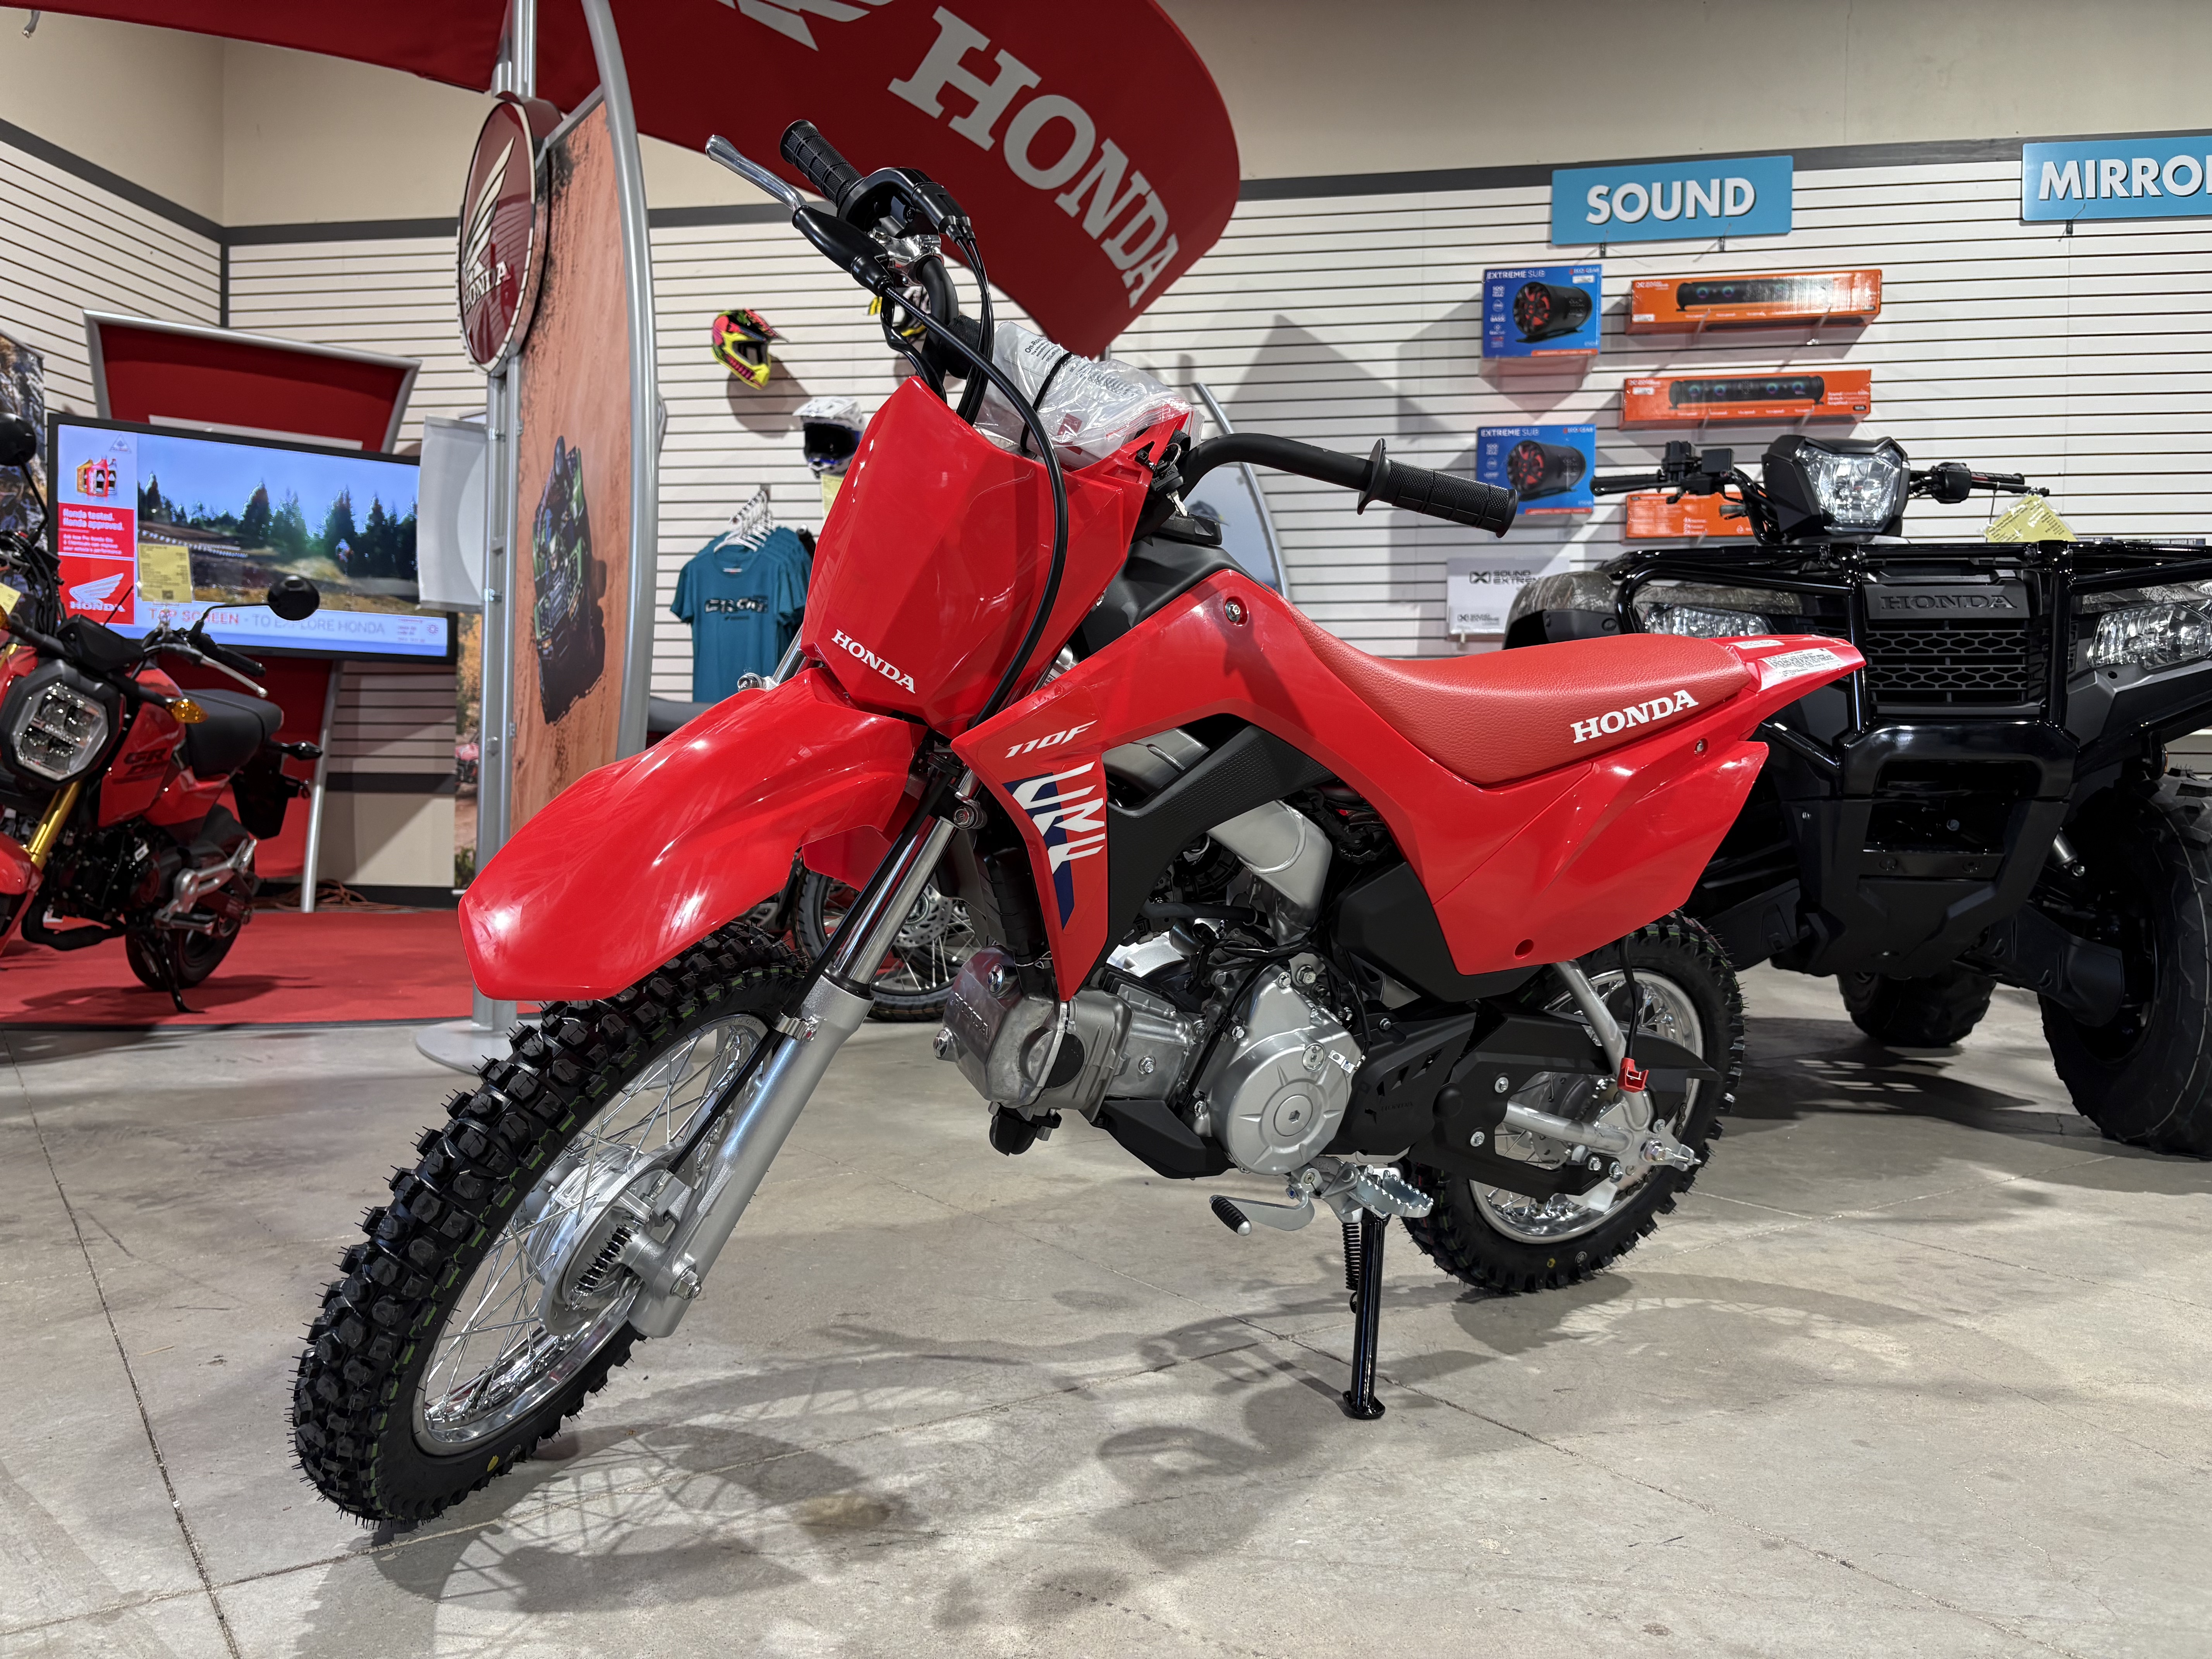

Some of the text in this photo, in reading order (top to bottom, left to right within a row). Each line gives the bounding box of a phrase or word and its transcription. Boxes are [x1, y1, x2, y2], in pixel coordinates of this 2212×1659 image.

[887, 5, 1179, 309] HONDA
[2038, 155, 2212, 201] MIRRO
[1586, 177, 1756, 225] SOUND
[1486, 271, 1527, 280] EXTREME
[1522, 428, 1539, 436] SUB
[70, 601, 126, 612] HONDA
[1880, 595, 2018, 610] HONDA
[252, 614, 270, 627] TO
[338, 619, 385, 635] HONDA
[831, 629, 916, 694] HONDA
[1570, 689, 1699, 744] HONDA
[1004, 720, 1098, 759] 110F
[1012, 761, 1106, 875] CRF
